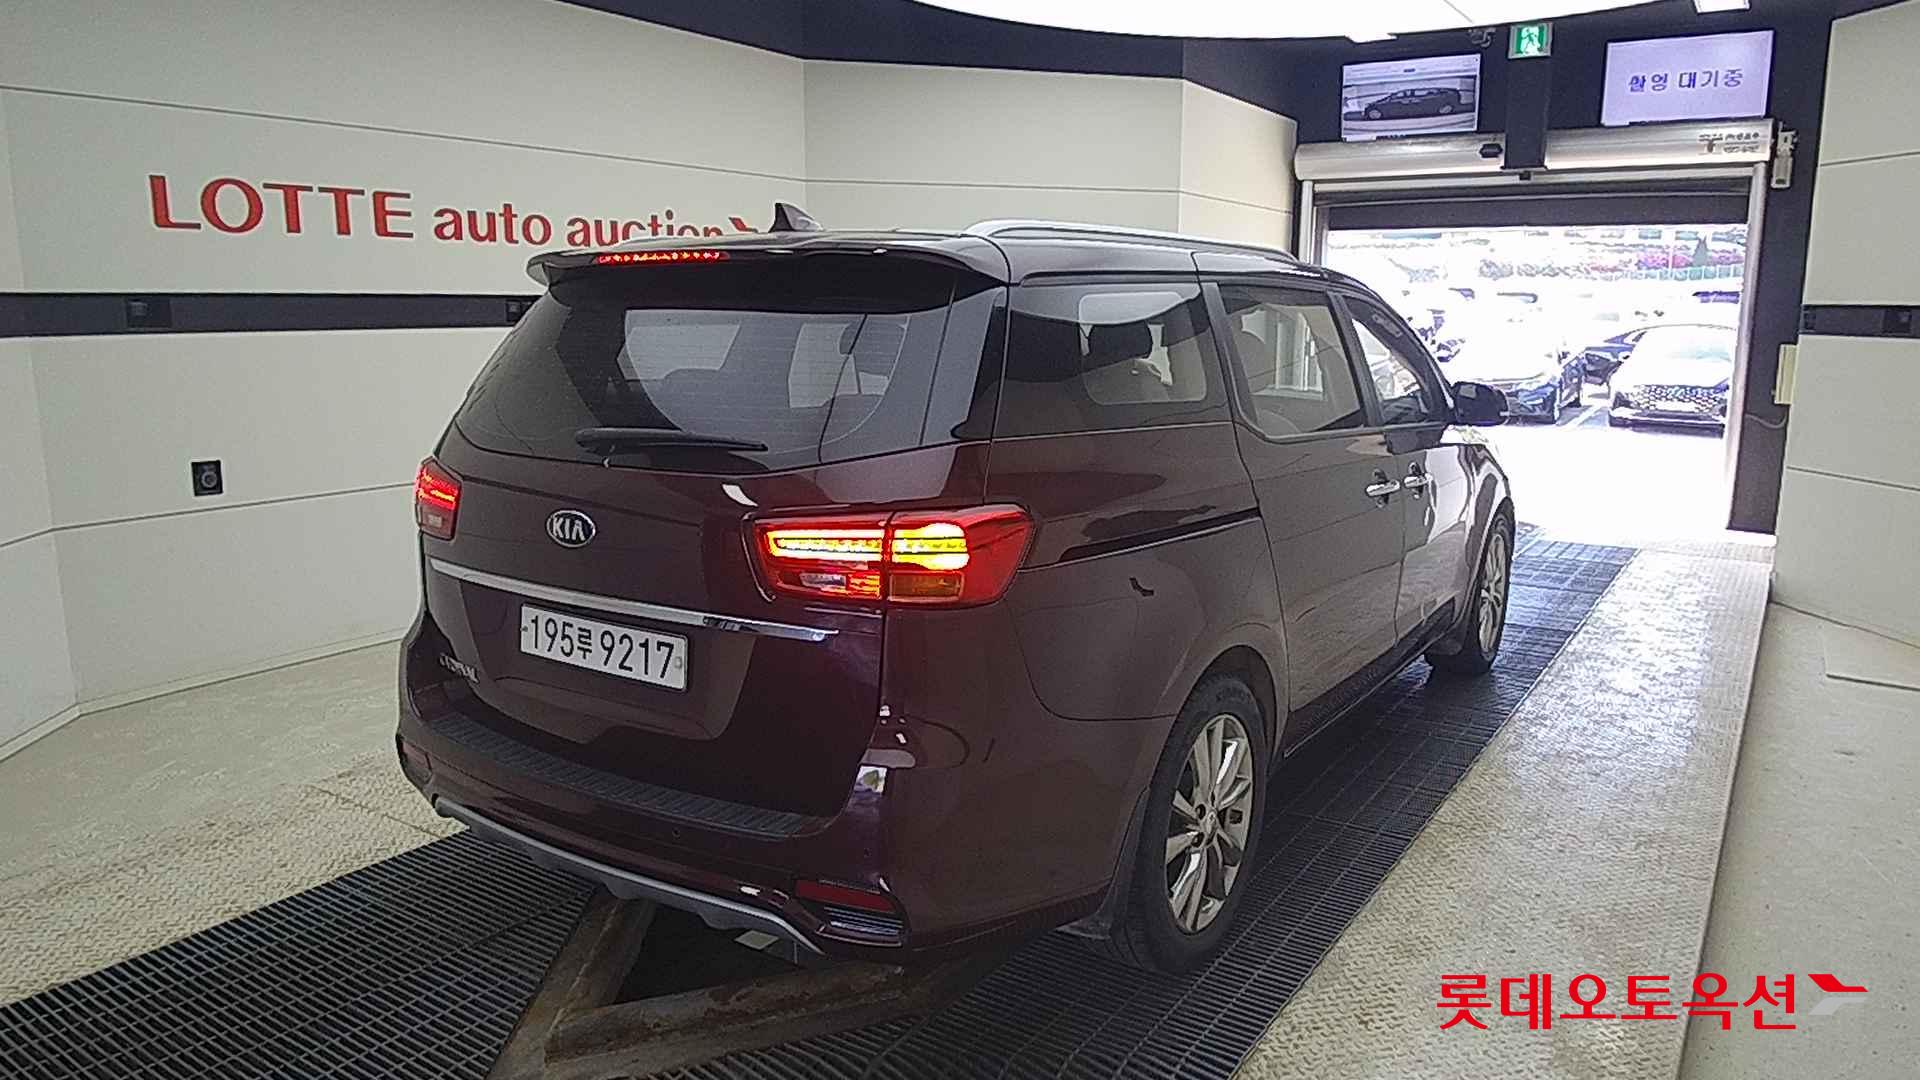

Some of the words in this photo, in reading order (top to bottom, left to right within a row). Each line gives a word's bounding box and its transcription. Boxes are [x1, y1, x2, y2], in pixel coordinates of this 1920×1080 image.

[1678, 69, 1743, 88] 대기중
[149, 175, 414, 239] LOTTE
[433, 203, 552, 246] auto
[553, 517, 586, 541] KIA
